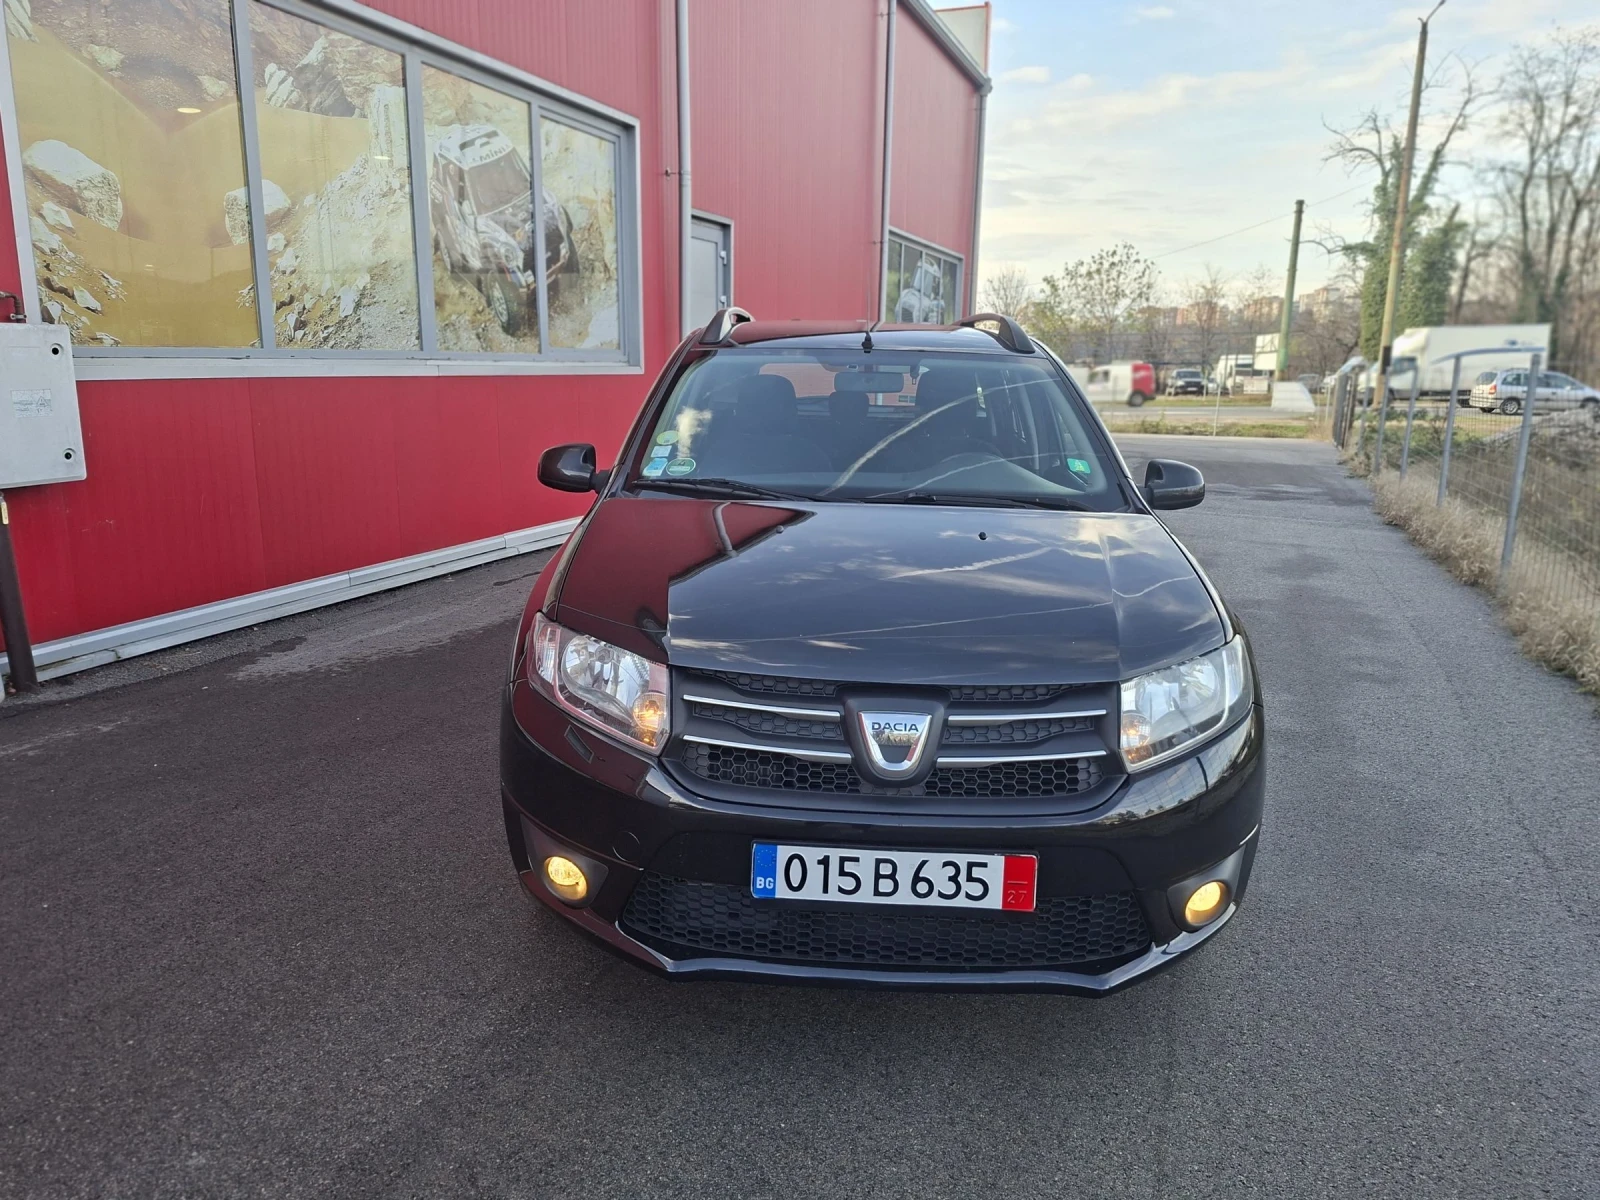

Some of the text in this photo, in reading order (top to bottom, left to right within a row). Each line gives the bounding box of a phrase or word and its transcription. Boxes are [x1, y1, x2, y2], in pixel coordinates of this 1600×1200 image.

[871, 721, 919, 732] DACIA
[756, 876, 774, 889] BG
[1007, 889, 1027, 904] 27
